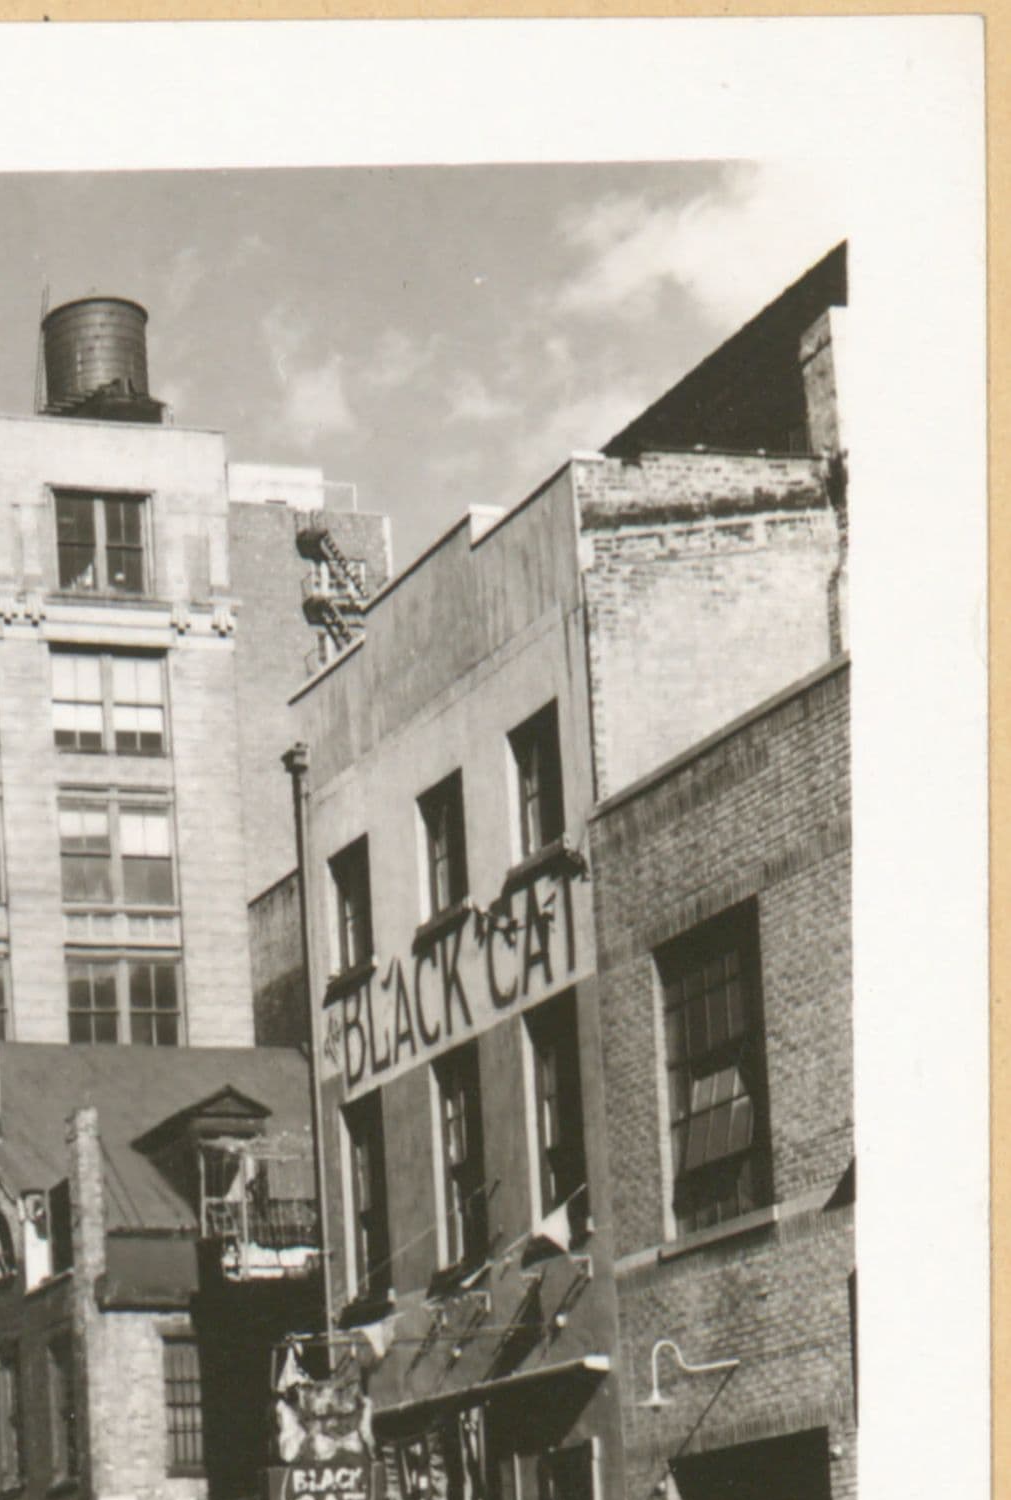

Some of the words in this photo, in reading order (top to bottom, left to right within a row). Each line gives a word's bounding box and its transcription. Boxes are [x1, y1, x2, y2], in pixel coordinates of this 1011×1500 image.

[342, 916, 472, 1088] BLACK
[486, 872, 576, 1010] CAT
[293, 1467, 362, 1493] BLACK
